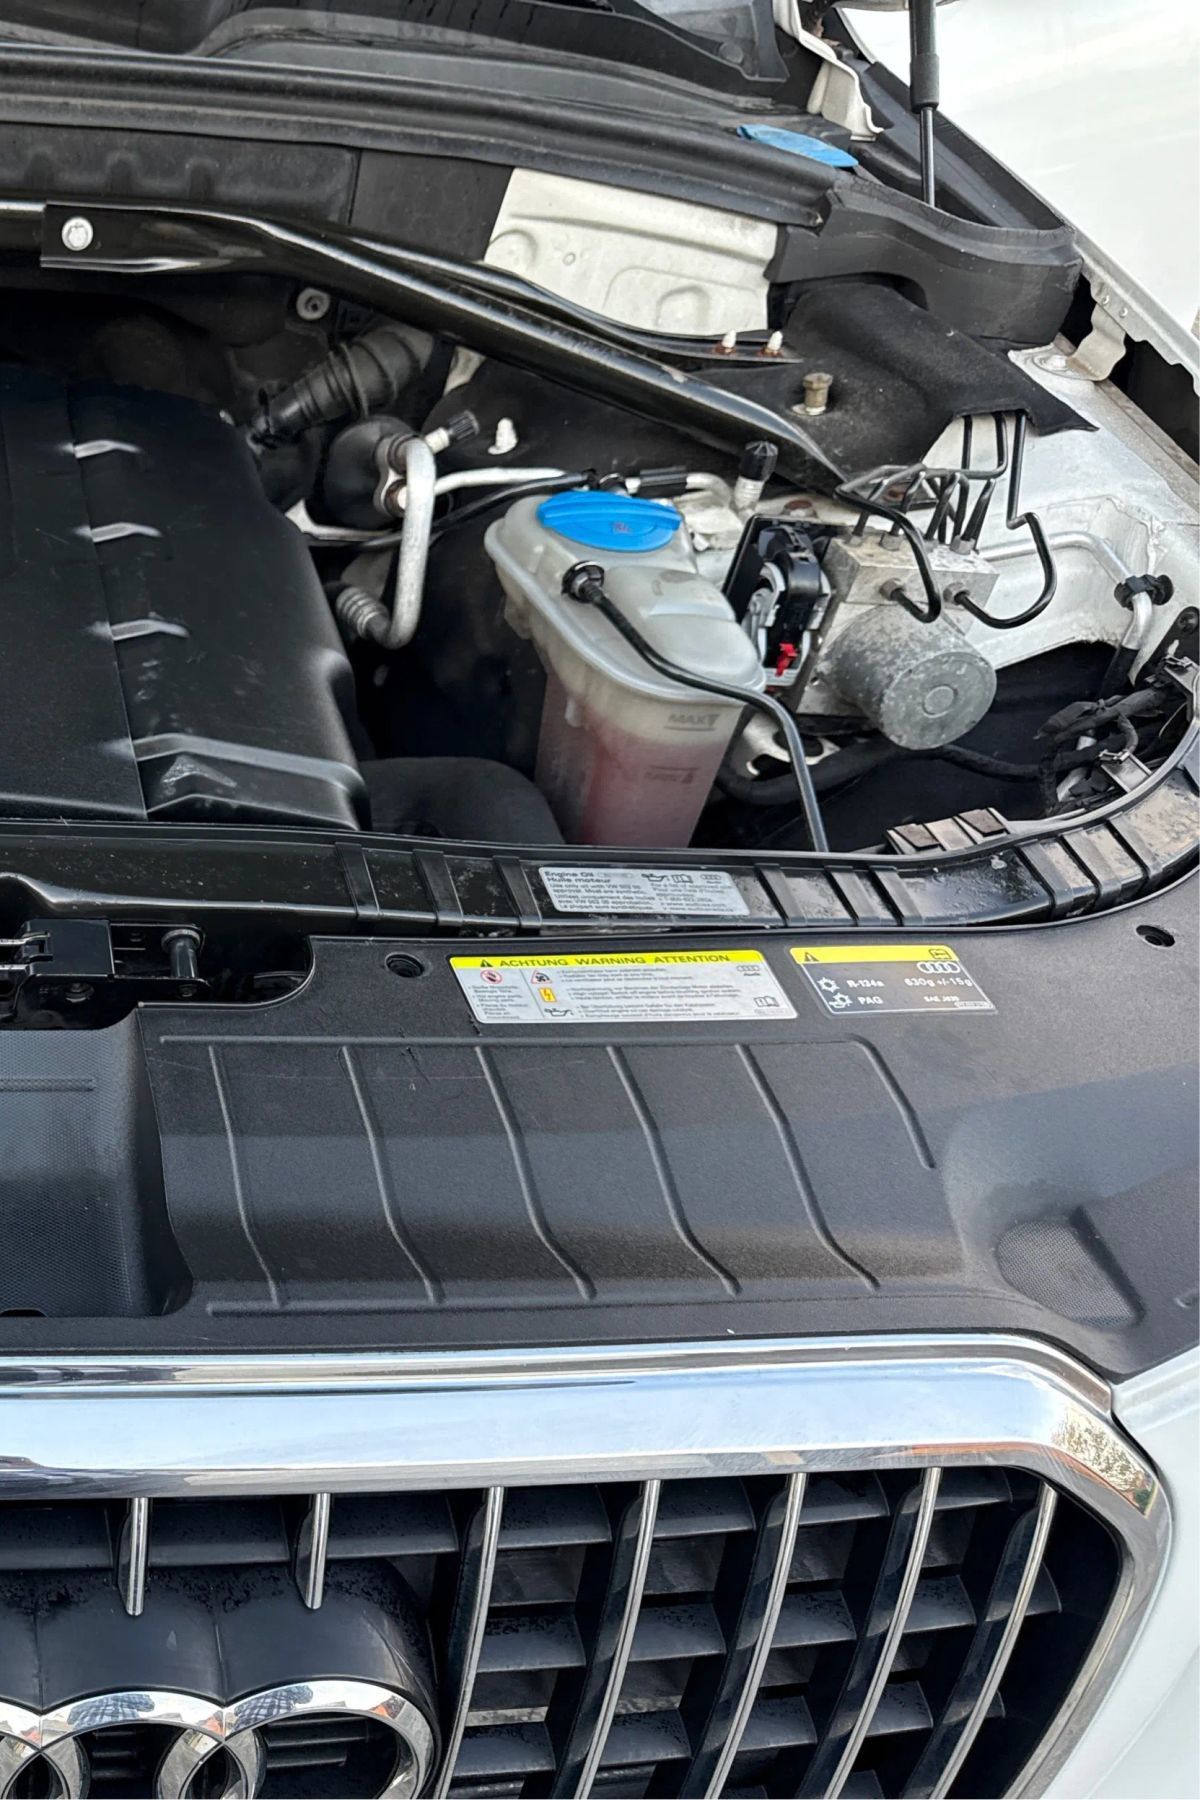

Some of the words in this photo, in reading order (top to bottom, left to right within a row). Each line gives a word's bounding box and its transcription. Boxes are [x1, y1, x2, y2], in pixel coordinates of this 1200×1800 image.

[667, 713, 707, 726] MAX
[499, 958, 569, 967] ACHTUNG
[574, 956, 647, 965] WARNING
[653, 954, 731, 964] ATTENTION
[846, 979, 885, 988] R-134a
[857, 996, 884, 1005] PAG
